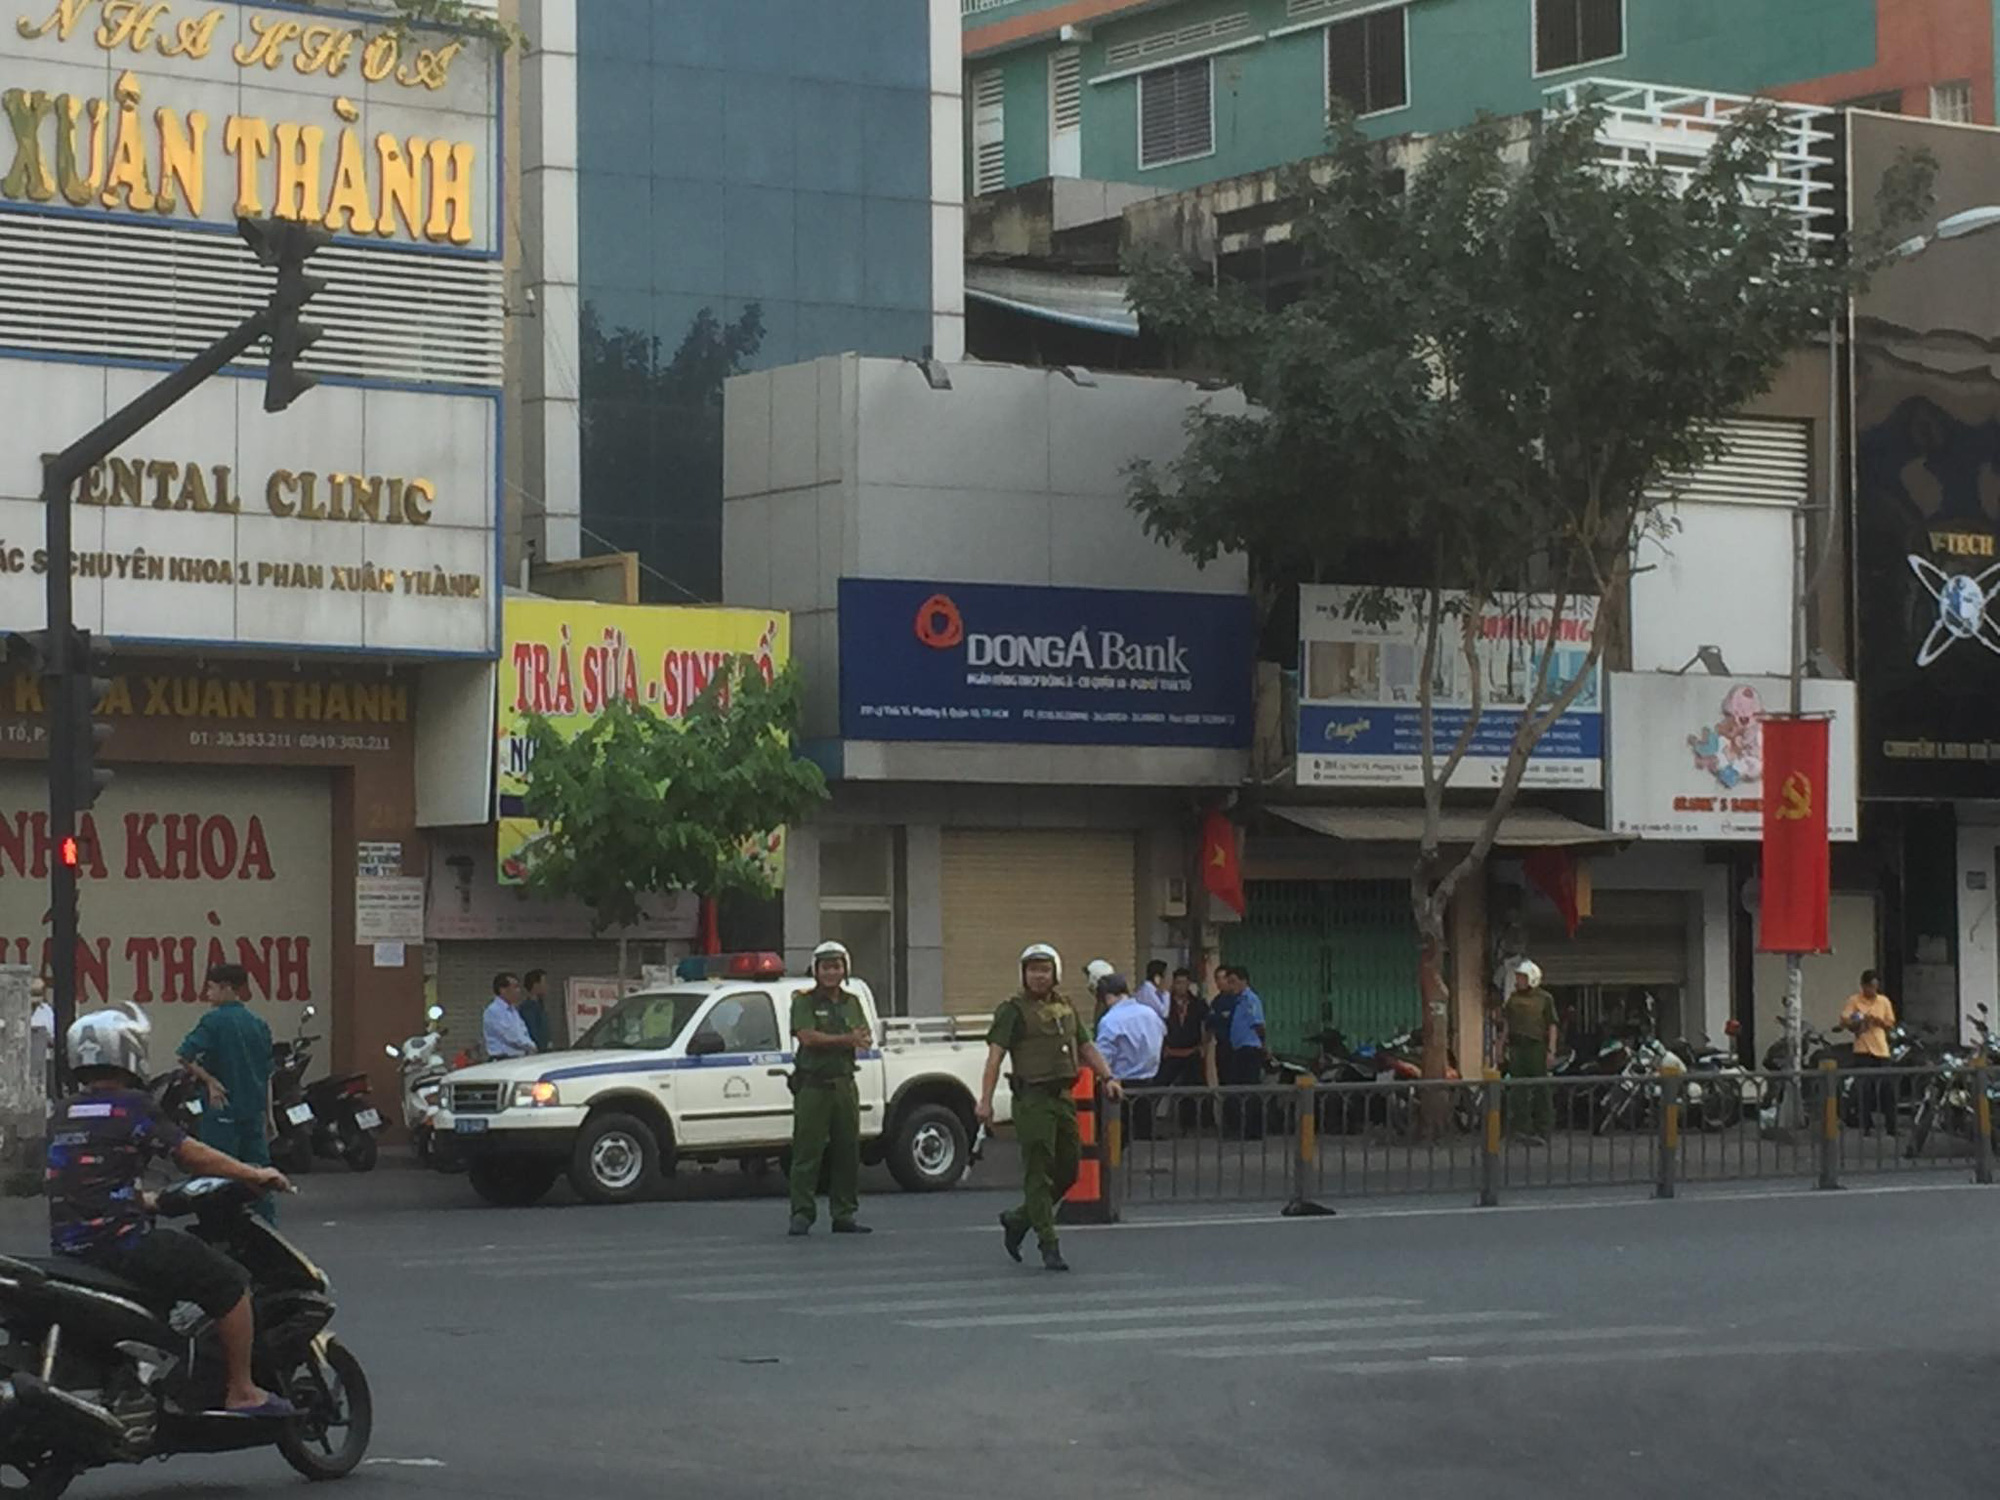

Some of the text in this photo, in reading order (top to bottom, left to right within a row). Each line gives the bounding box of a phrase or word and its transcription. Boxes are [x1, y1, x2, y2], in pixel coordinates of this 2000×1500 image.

[1, 70, 475, 244] XUÂN THÀNH
[40, 451, 437, 524] ENTAL CLINIC
[169, 557, 233, 585] KHOA
[330, 561, 396, 593] XUÂN
[401, 564, 482, 598] THÀNH
[513, 624, 576, 714] TRÀ
[1098, 631, 1190, 674] Bank
[124, 812, 276, 880] KHOA
[125, 910, 311, 1004] THÀNH
